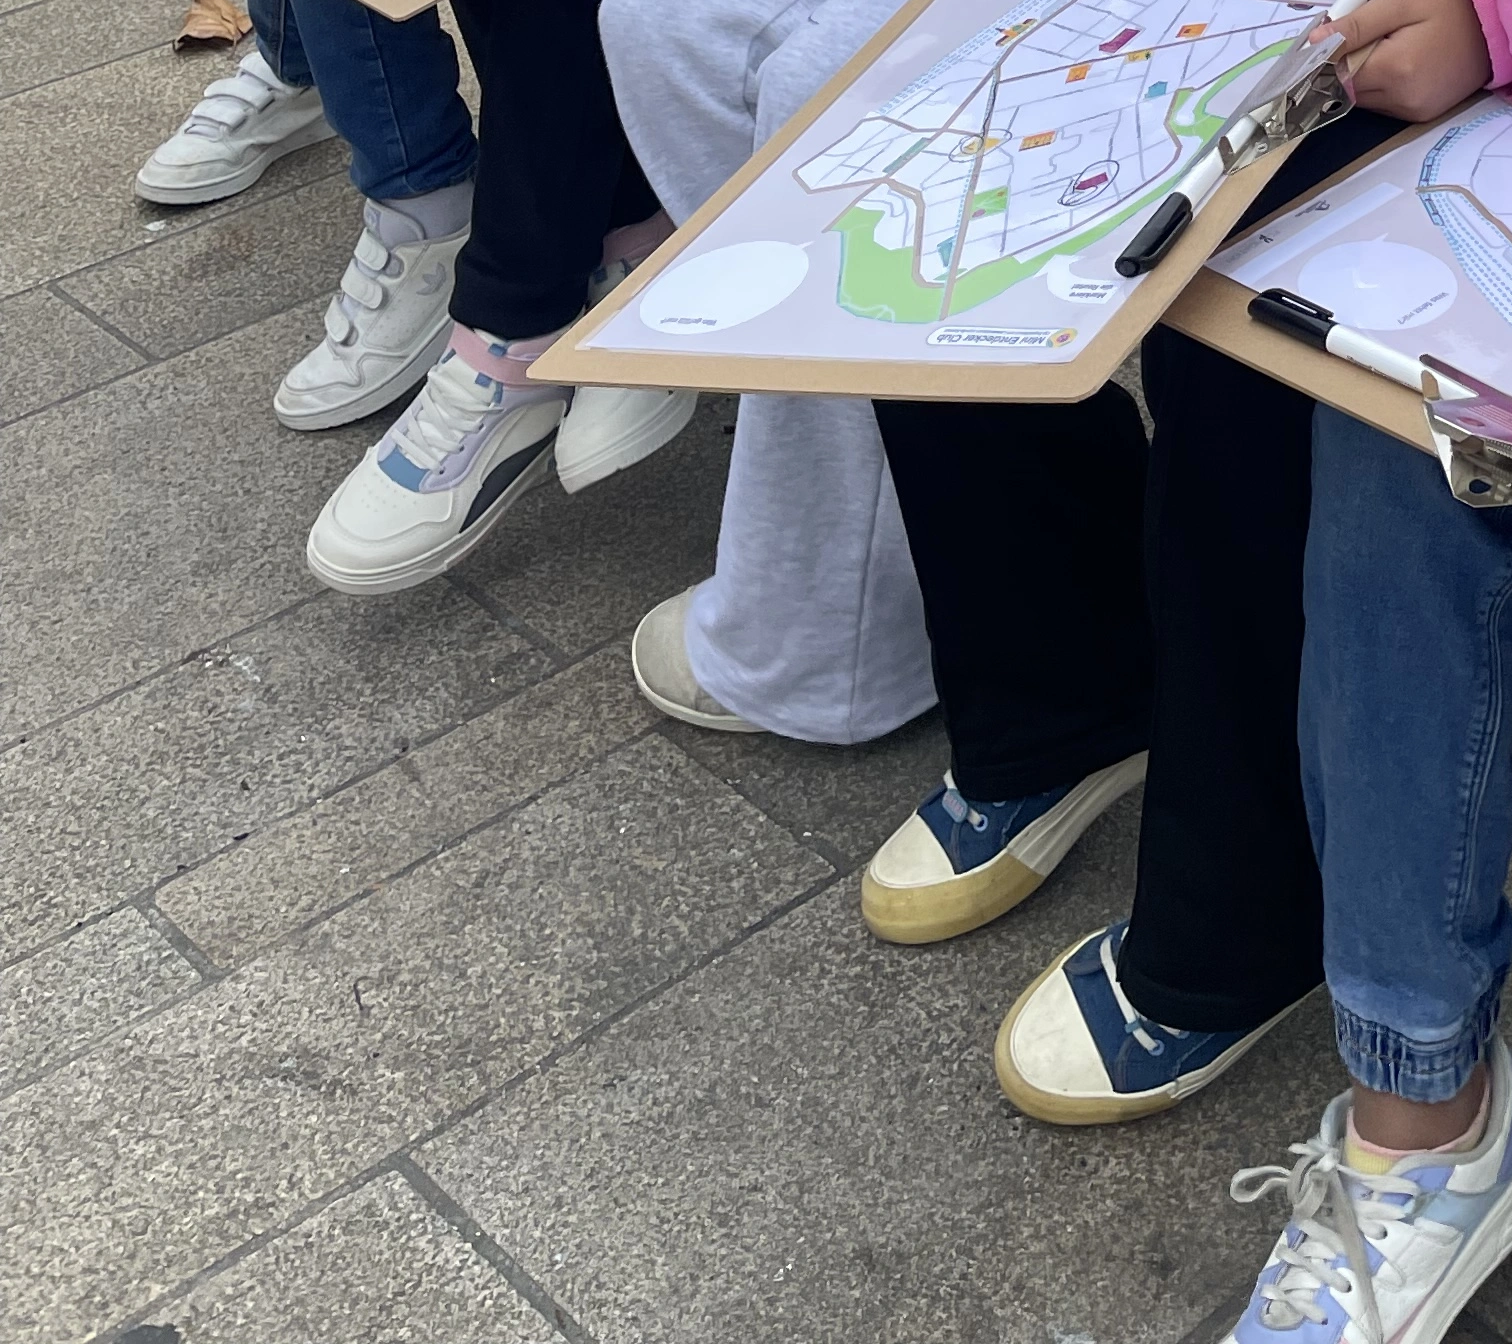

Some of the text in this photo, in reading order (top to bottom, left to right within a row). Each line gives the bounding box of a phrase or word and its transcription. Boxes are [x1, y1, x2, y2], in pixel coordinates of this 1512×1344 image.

[937, 334, 1047, 345] Mini Entdecker Club
